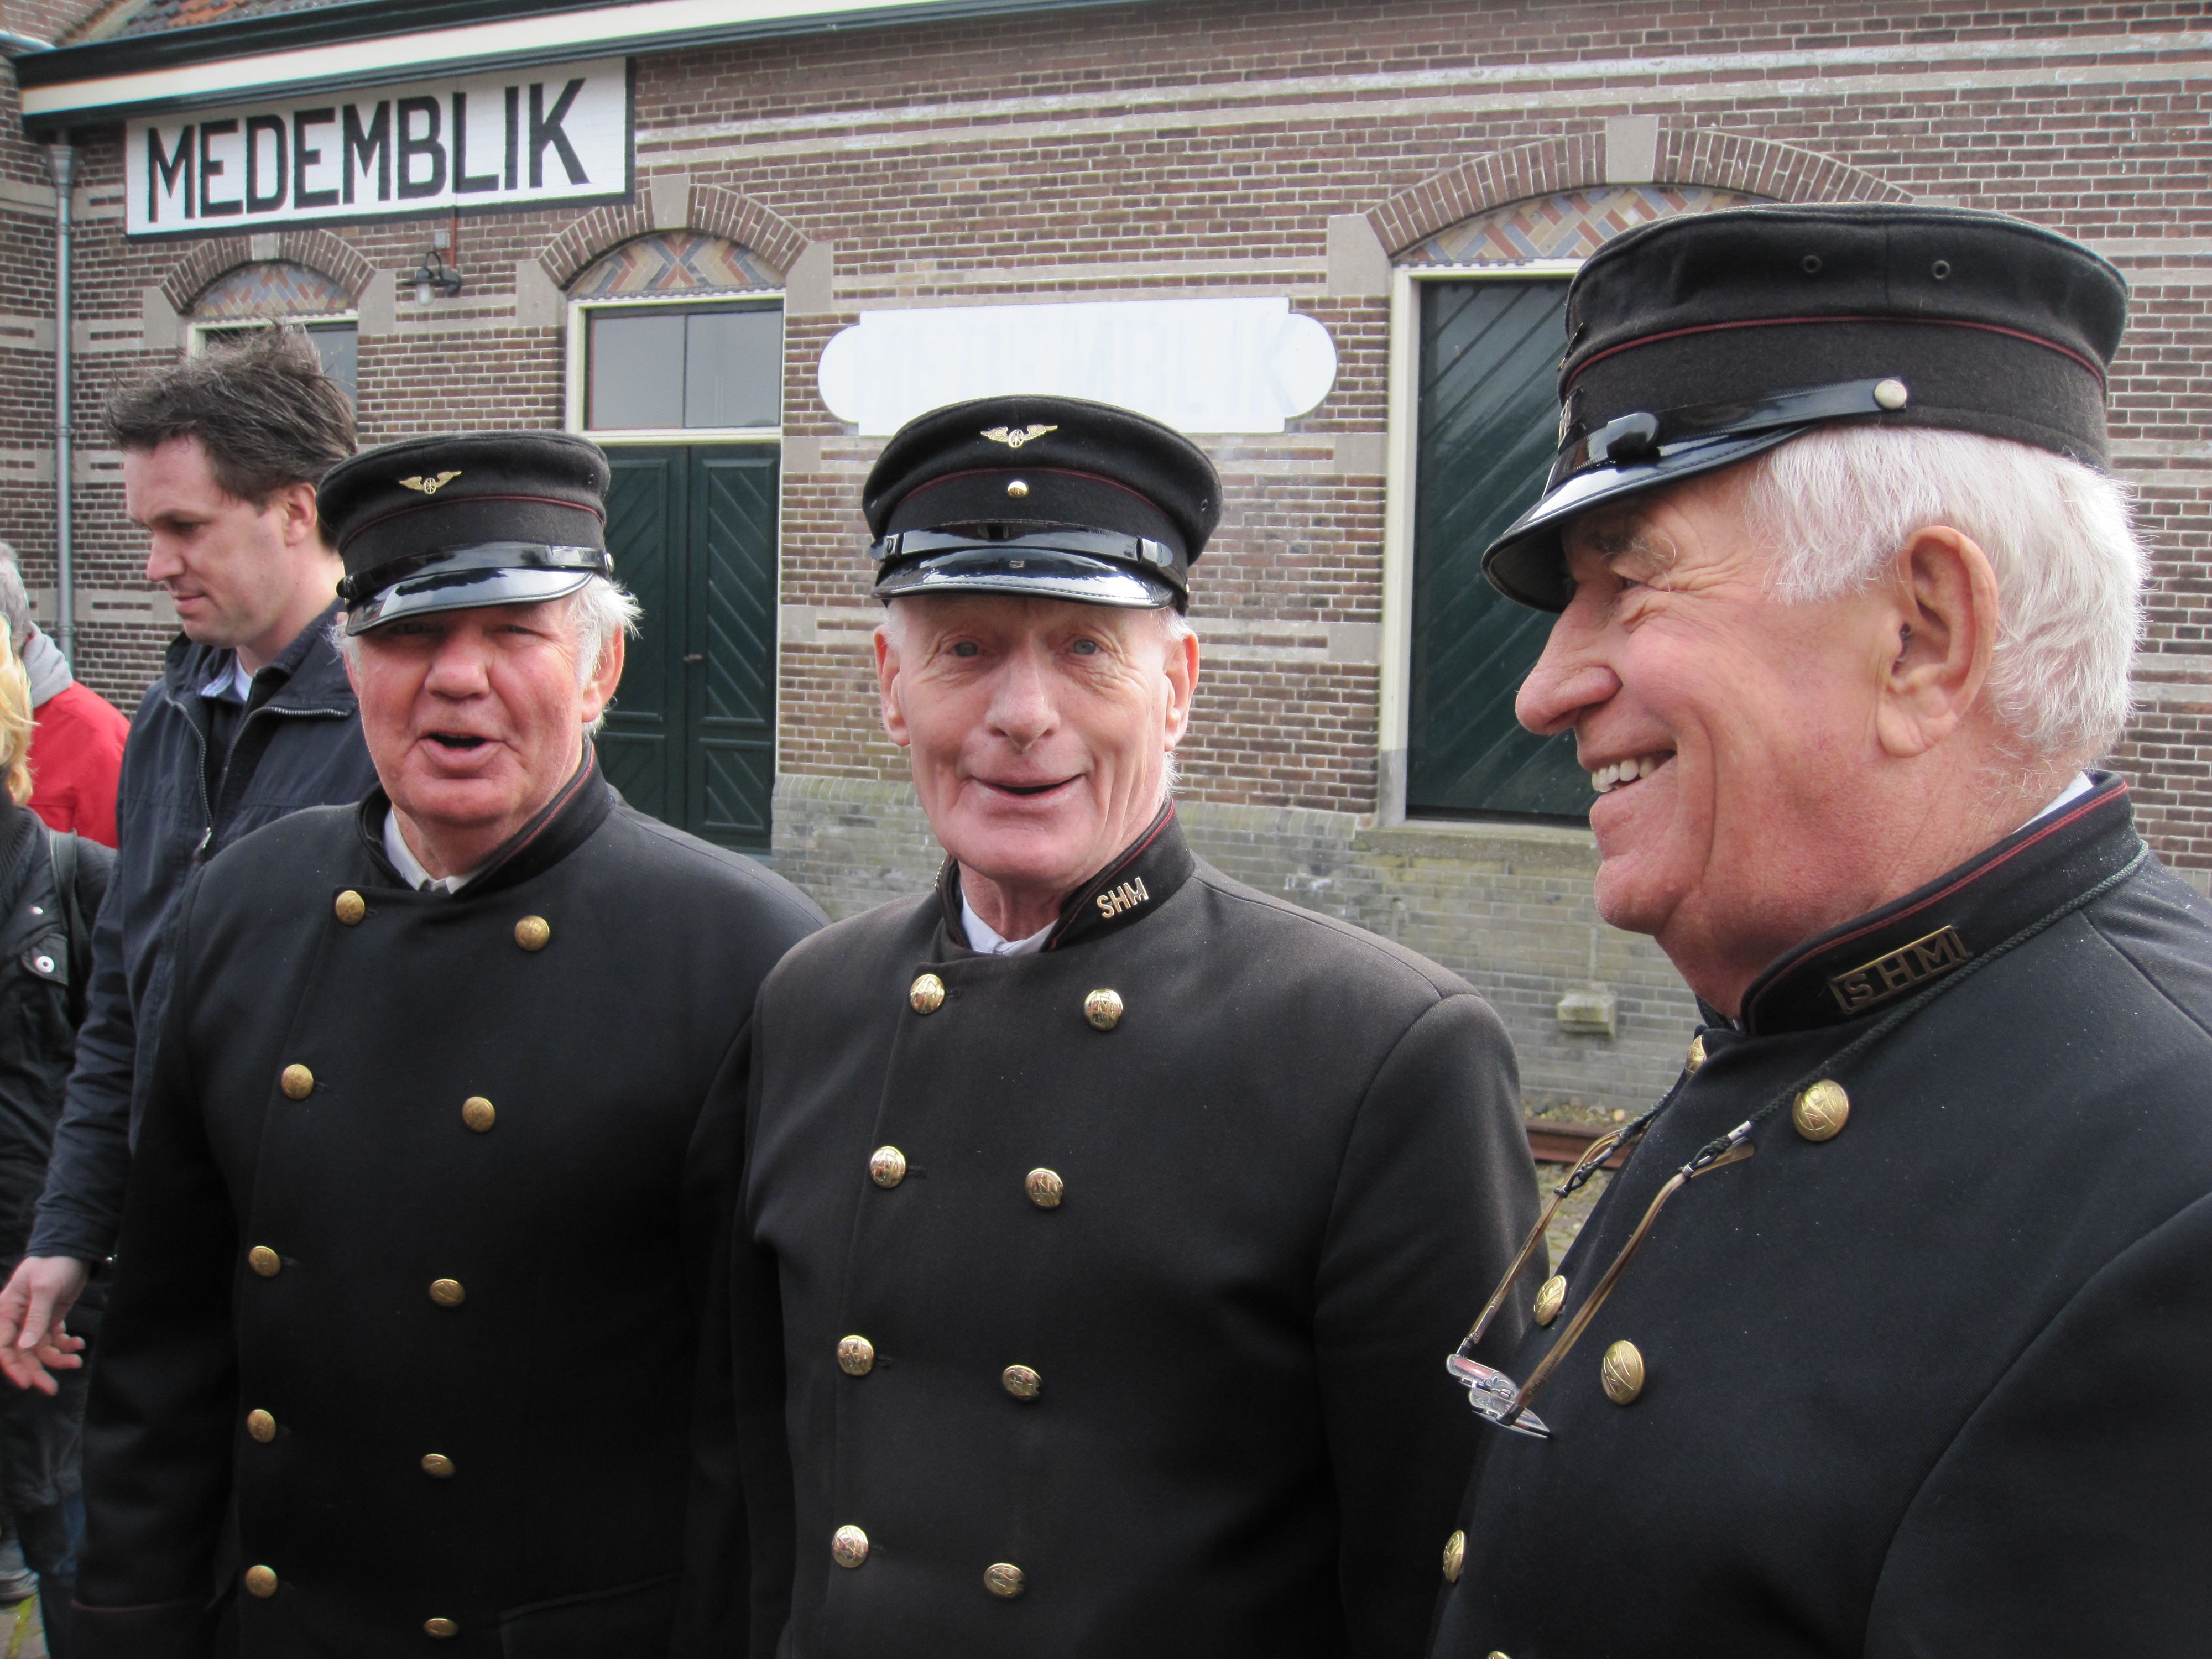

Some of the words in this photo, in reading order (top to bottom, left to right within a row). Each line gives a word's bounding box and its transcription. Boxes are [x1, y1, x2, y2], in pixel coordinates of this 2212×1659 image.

[148, 77, 591, 223] MEDEMBLIK
[1097, 877, 1149, 919] SHM
[1843, 930, 1959, 1008] SHM
